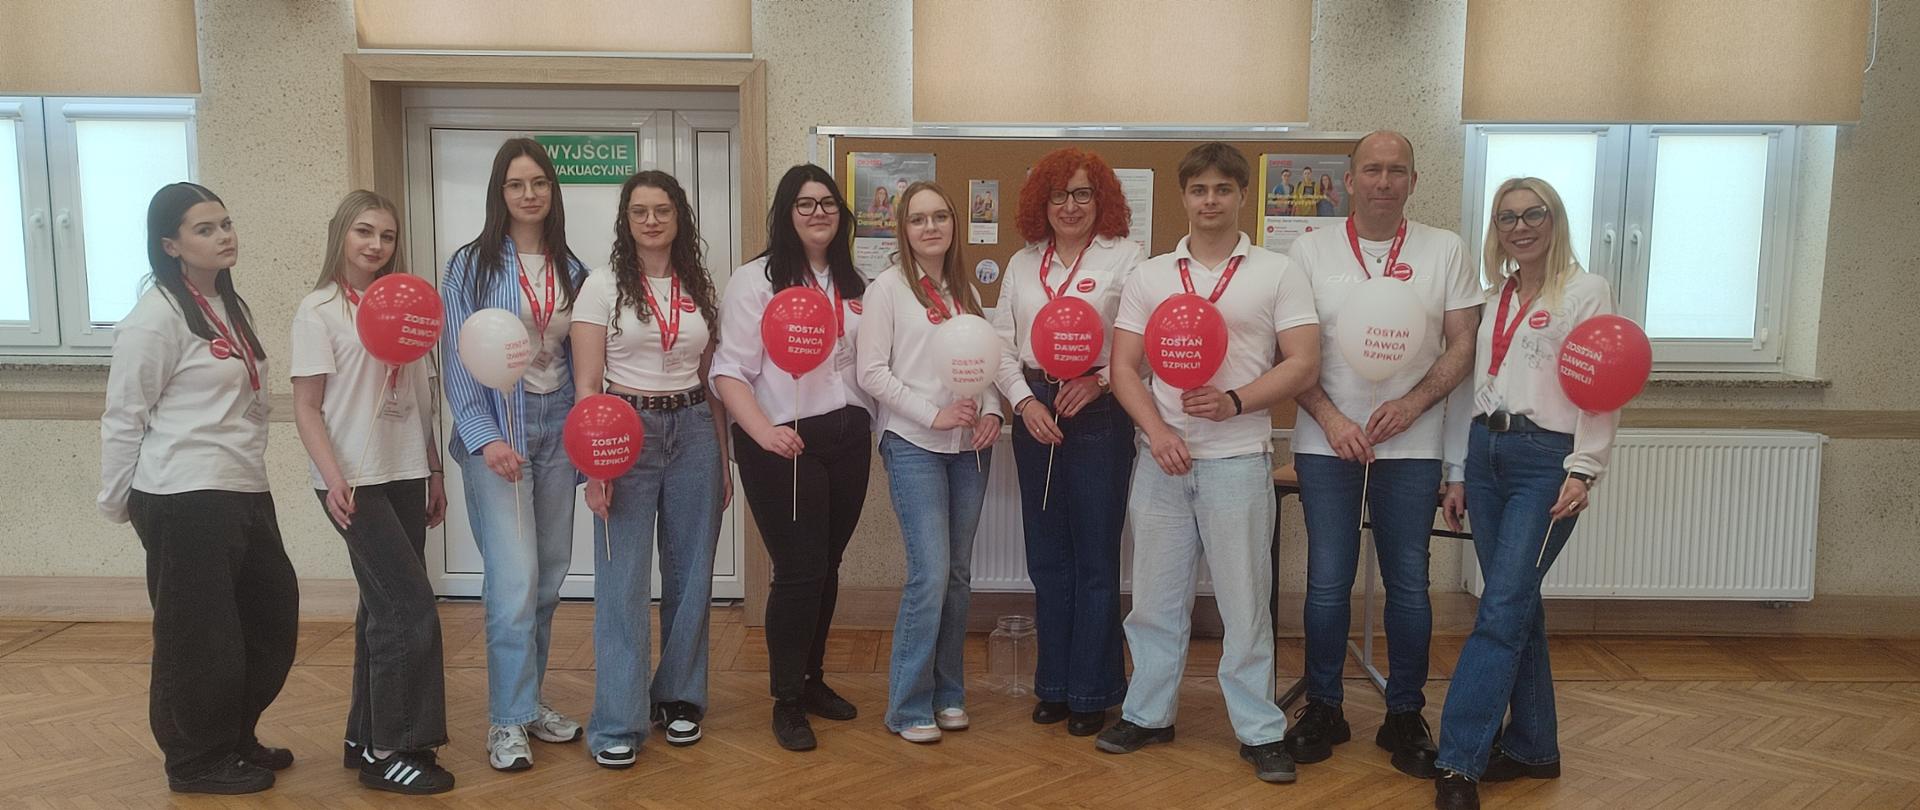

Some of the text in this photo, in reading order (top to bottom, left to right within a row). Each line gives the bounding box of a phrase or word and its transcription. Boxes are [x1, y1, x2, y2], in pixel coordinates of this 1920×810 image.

[542, 140, 628, 160] WYJŚCIE
[552, 164, 633, 177] WAKUACYJNE
[788, 324, 825, 334] ZOSTAŃ
[1366, 326, 1410, 338] ZOSTAŃ
[788, 336, 822, 347] DAWCĄ
[1053, 331, 1092, 341] ZOSTAŃ
[1160, 336, 1203, 346] ZOSTAŃ
[1054, 343, 1090, 352] DAWCĄ
[1364, 338, 1406, 352] DAWCĄ
[1160, 349, 1202, 360] DAWCĄ
[1363, 350, 1403, 361] SZPIKU!
[1566, 341, 1603, 362] ZOSTAŃ
[1162, 361, 1201, 369] SZPIKU!
[1561, 352, 1595, 375] DAWCĄ
[591, 433, 630, 446] ZOSTAŃ
[593, 446, 630, 457] DAWCĄ
